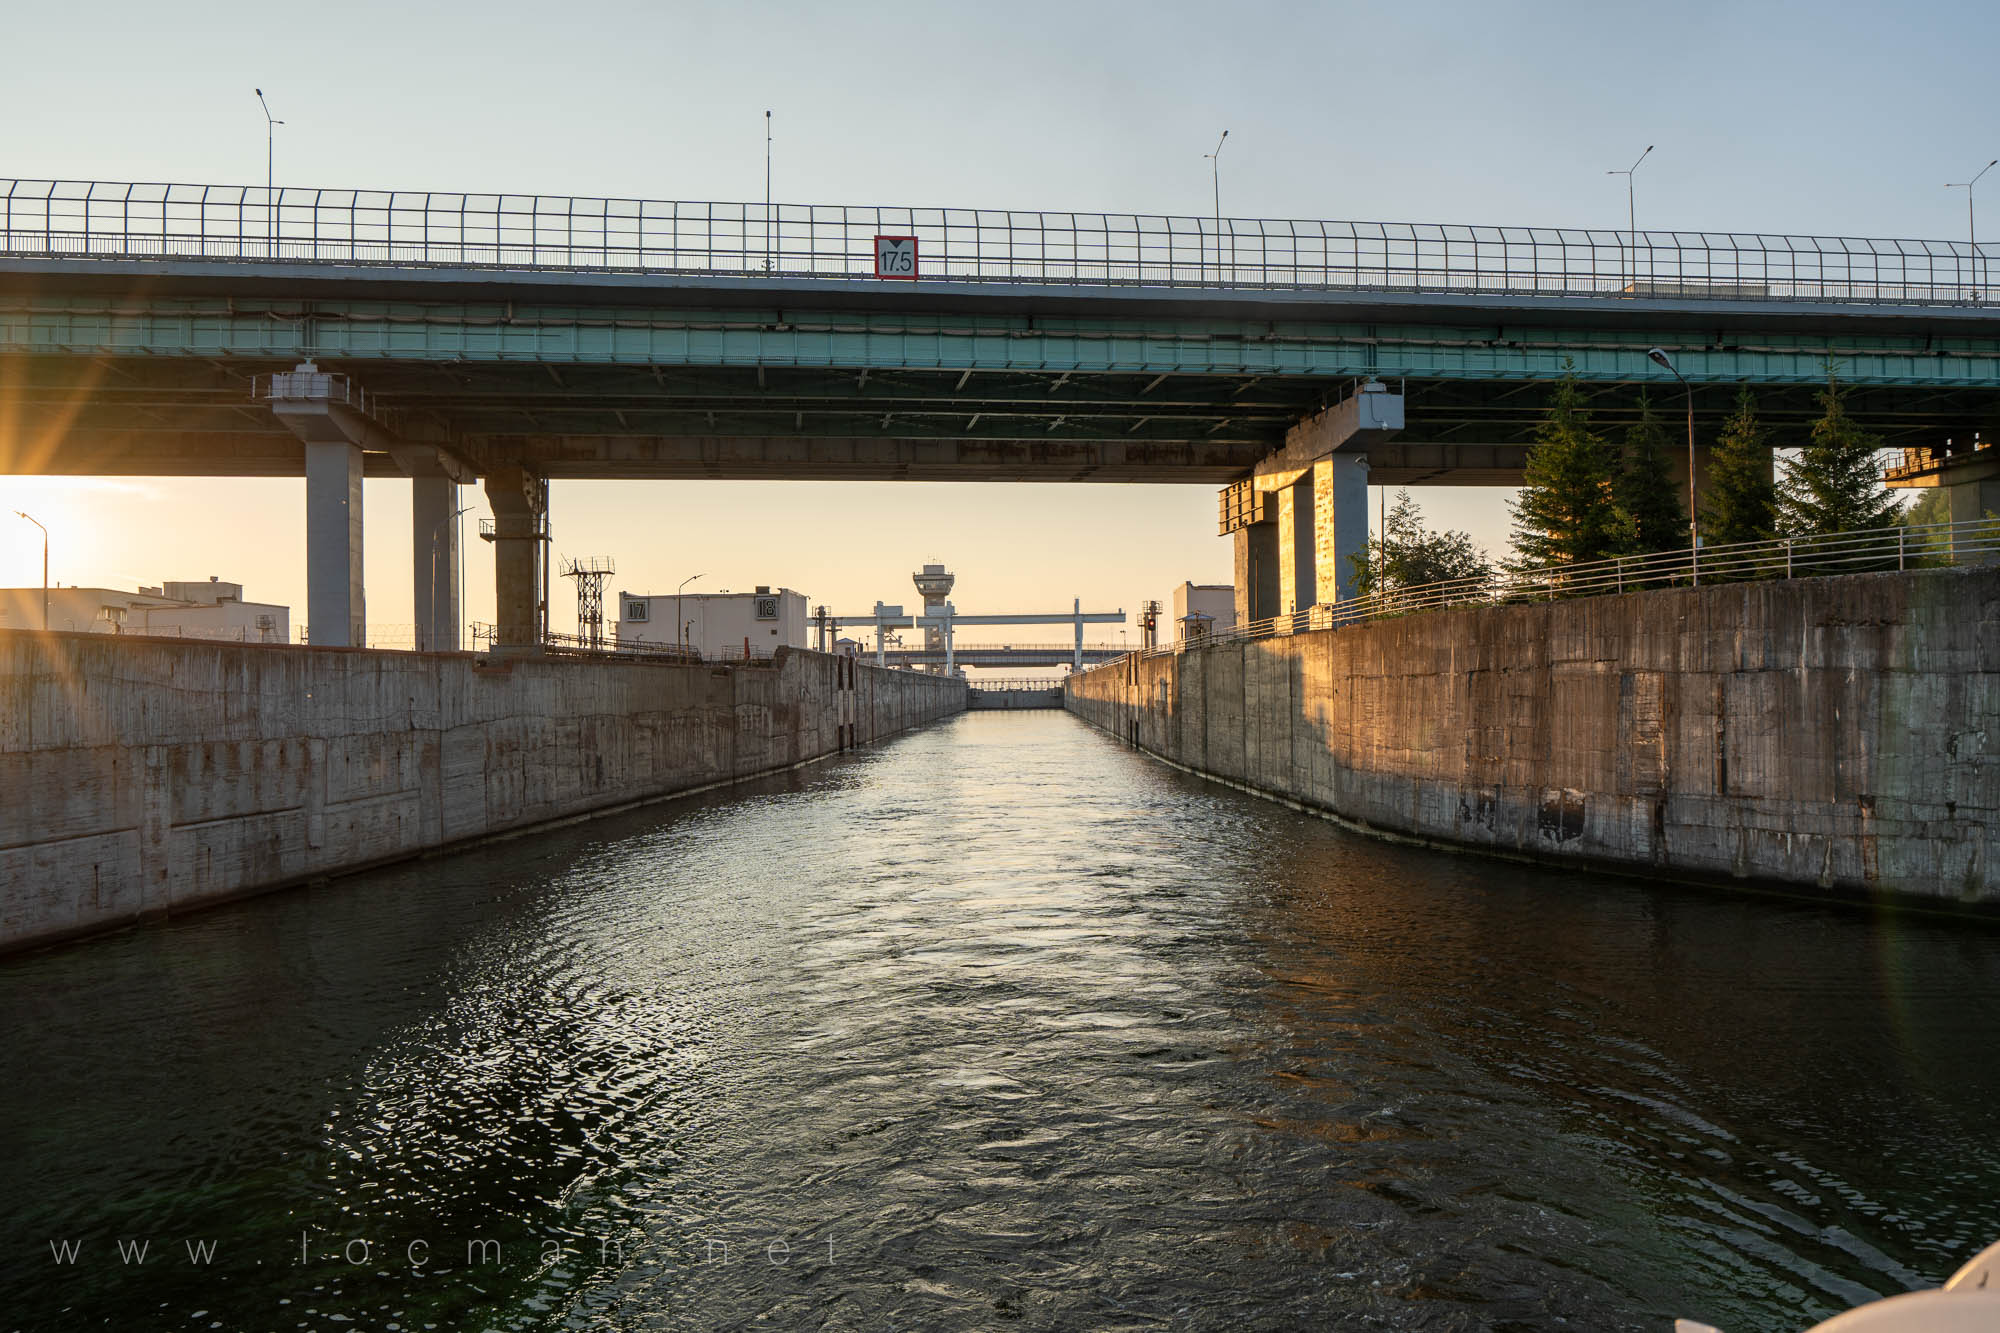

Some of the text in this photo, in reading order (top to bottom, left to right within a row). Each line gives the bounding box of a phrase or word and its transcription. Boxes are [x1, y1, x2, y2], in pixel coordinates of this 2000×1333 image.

[881, 251, 912, 272] 17.5
[629, 603, 645, 618] 17
[759, 600, 774, 616] 18
